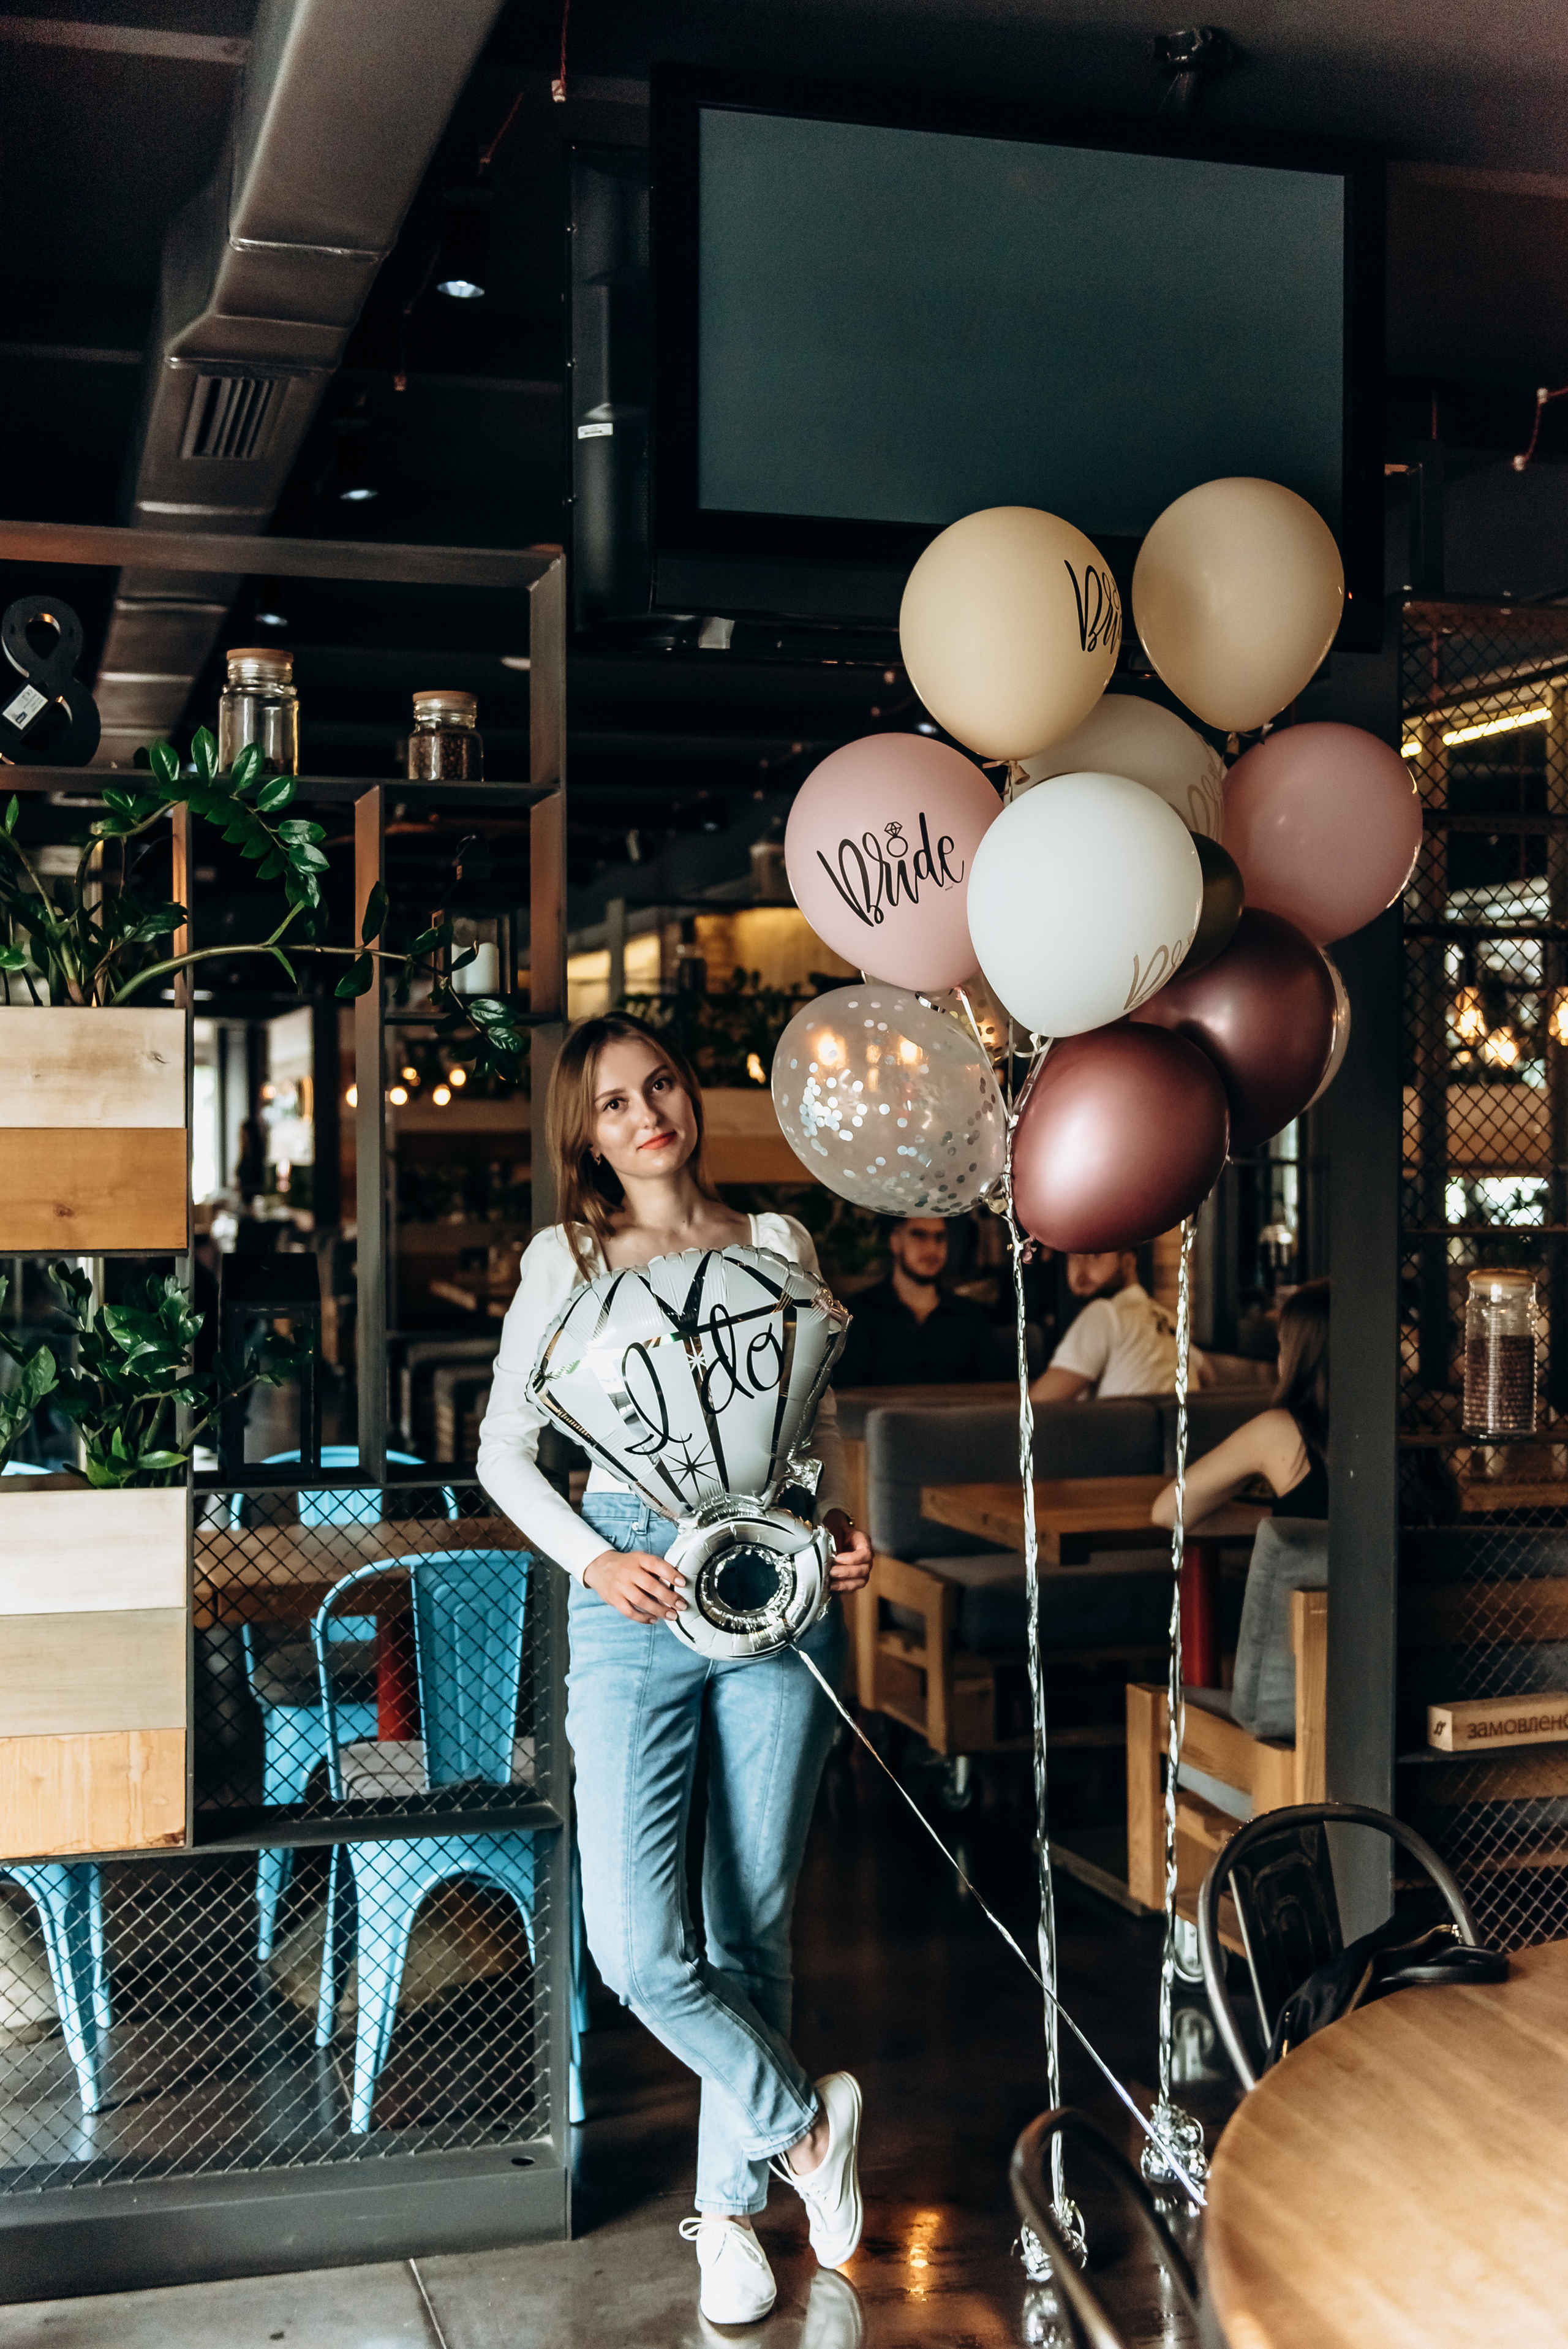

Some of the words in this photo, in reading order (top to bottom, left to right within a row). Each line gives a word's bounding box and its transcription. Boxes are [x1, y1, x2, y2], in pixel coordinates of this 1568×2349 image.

[816, 812, 965, 928] Bride
[622, 1342, 693, 1455] I
[701, 1303, 785, 1415] do
